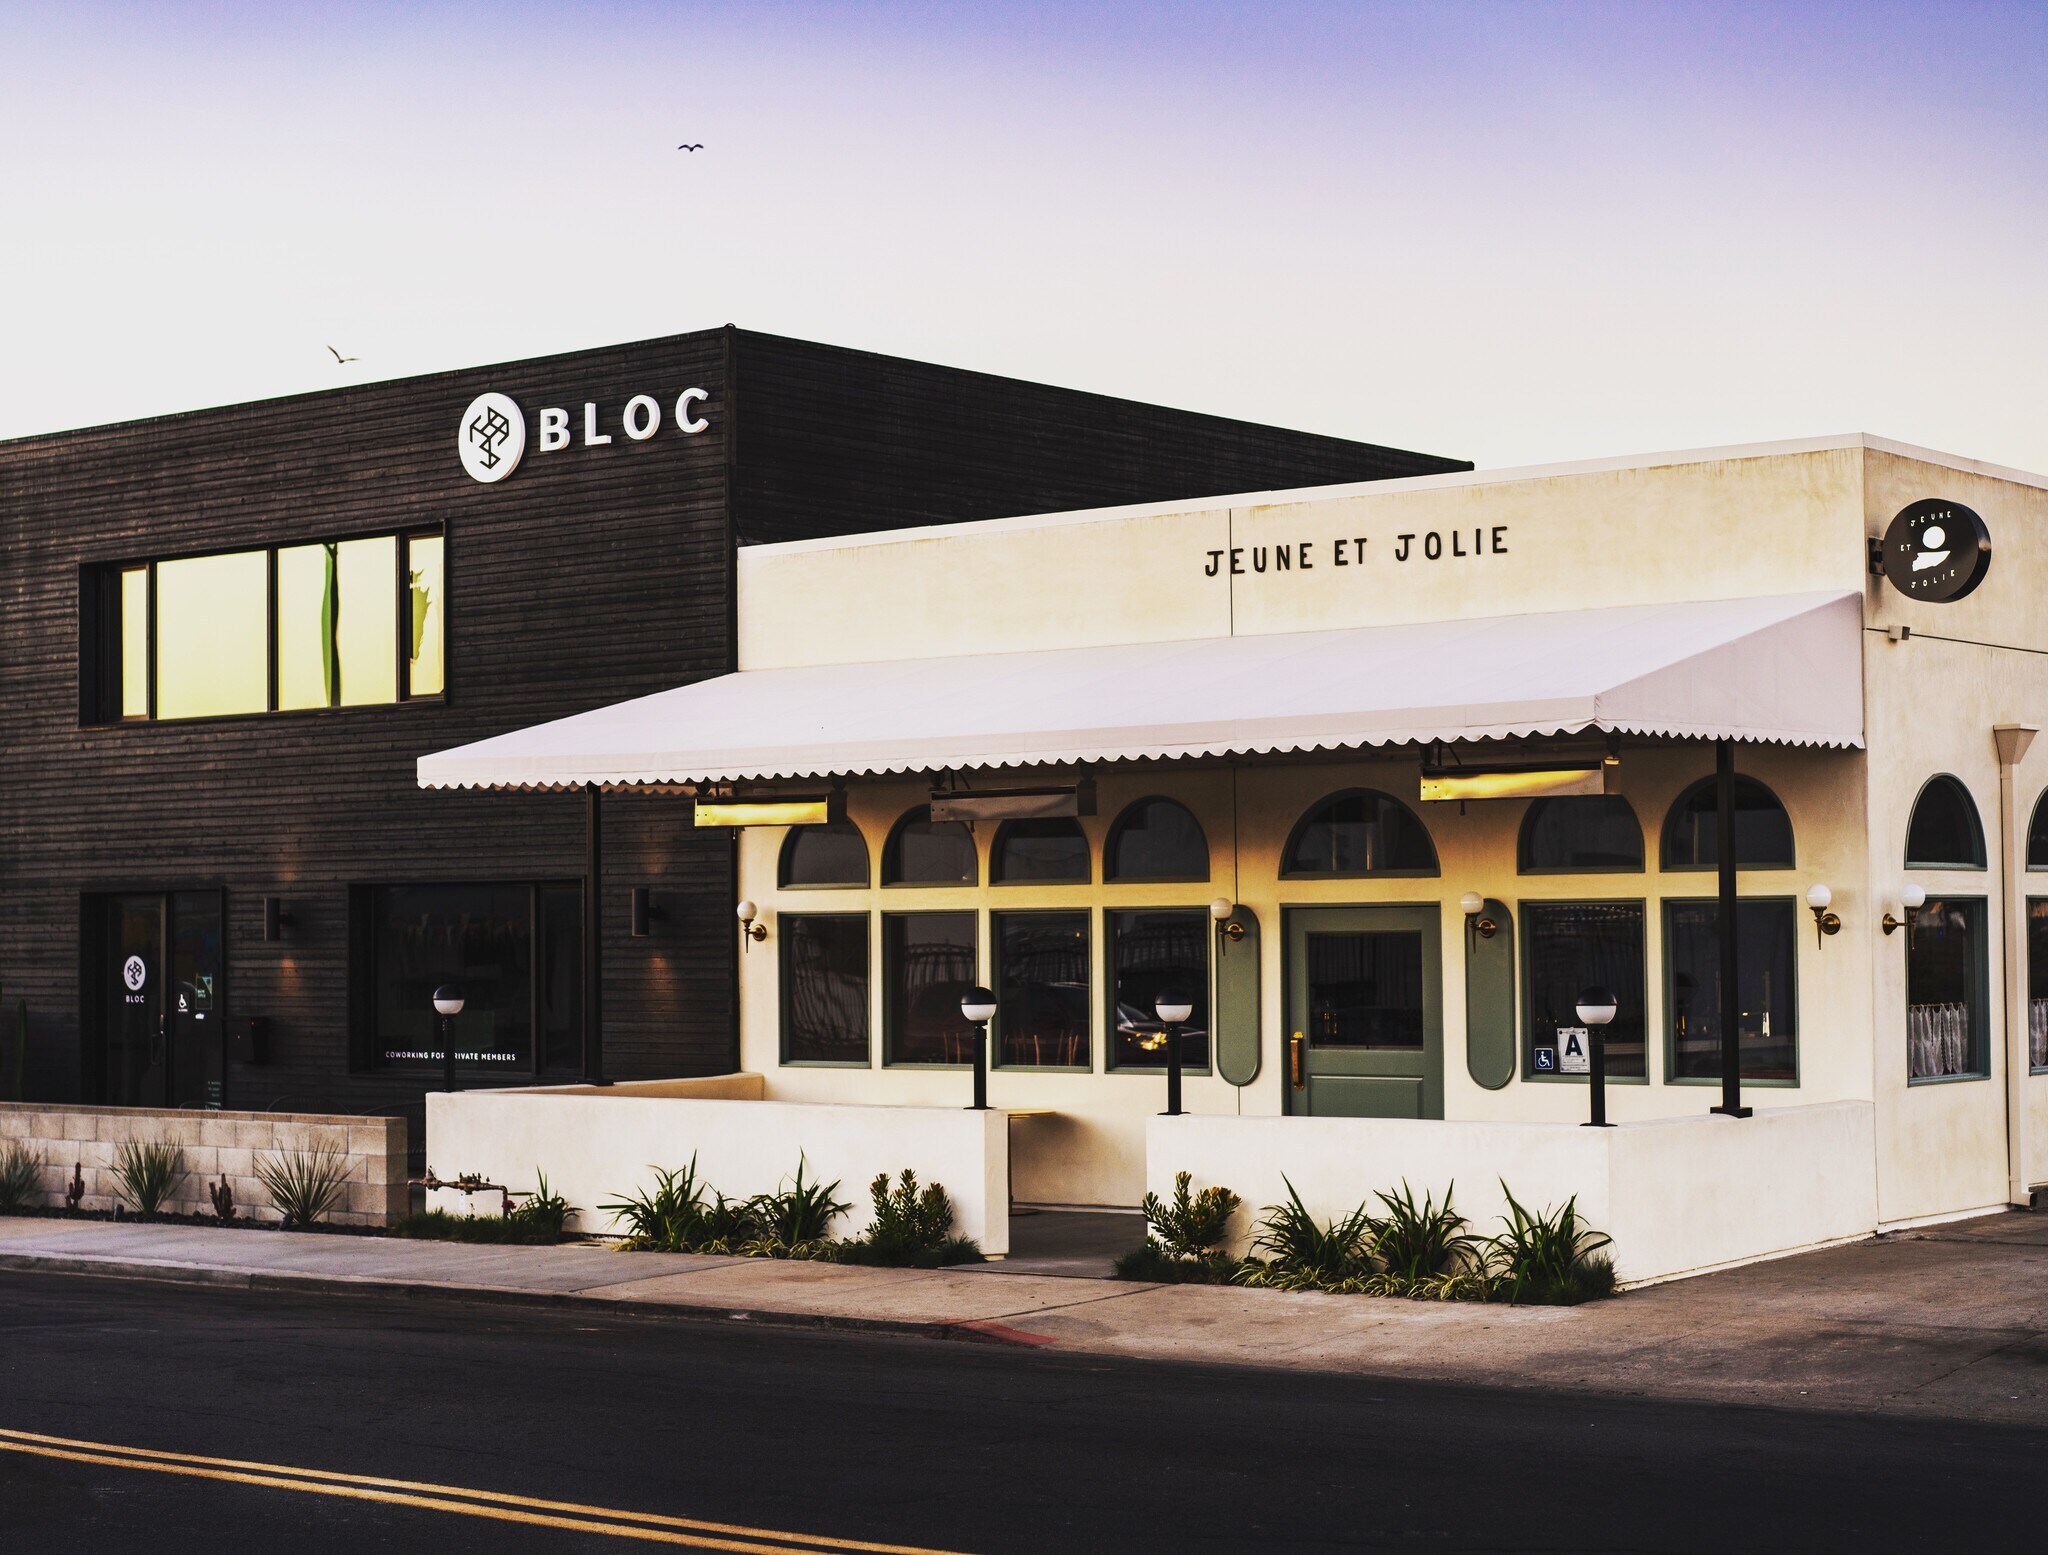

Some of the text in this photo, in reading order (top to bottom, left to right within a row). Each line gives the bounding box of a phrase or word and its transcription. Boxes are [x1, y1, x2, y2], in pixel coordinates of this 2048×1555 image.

[539, 387, 710, 452] BLOC
[1910, 510, 1952, 527] JEUNE
[1204, 525, 1508, 577] JEUNE ET JOLIE
[1900, 543, 1911, 552] ET
[1910, 569, 1955, 589] JOLIE
[125, 995, 145, 1003] BLOC
[1565, 1034, 1583, 1056] A
[385, 1051, 429, 1060] COWORKING
[454, 1052, 479, 1061] RIVATE
[481, 1052, 516, 1061] MEMBERS
